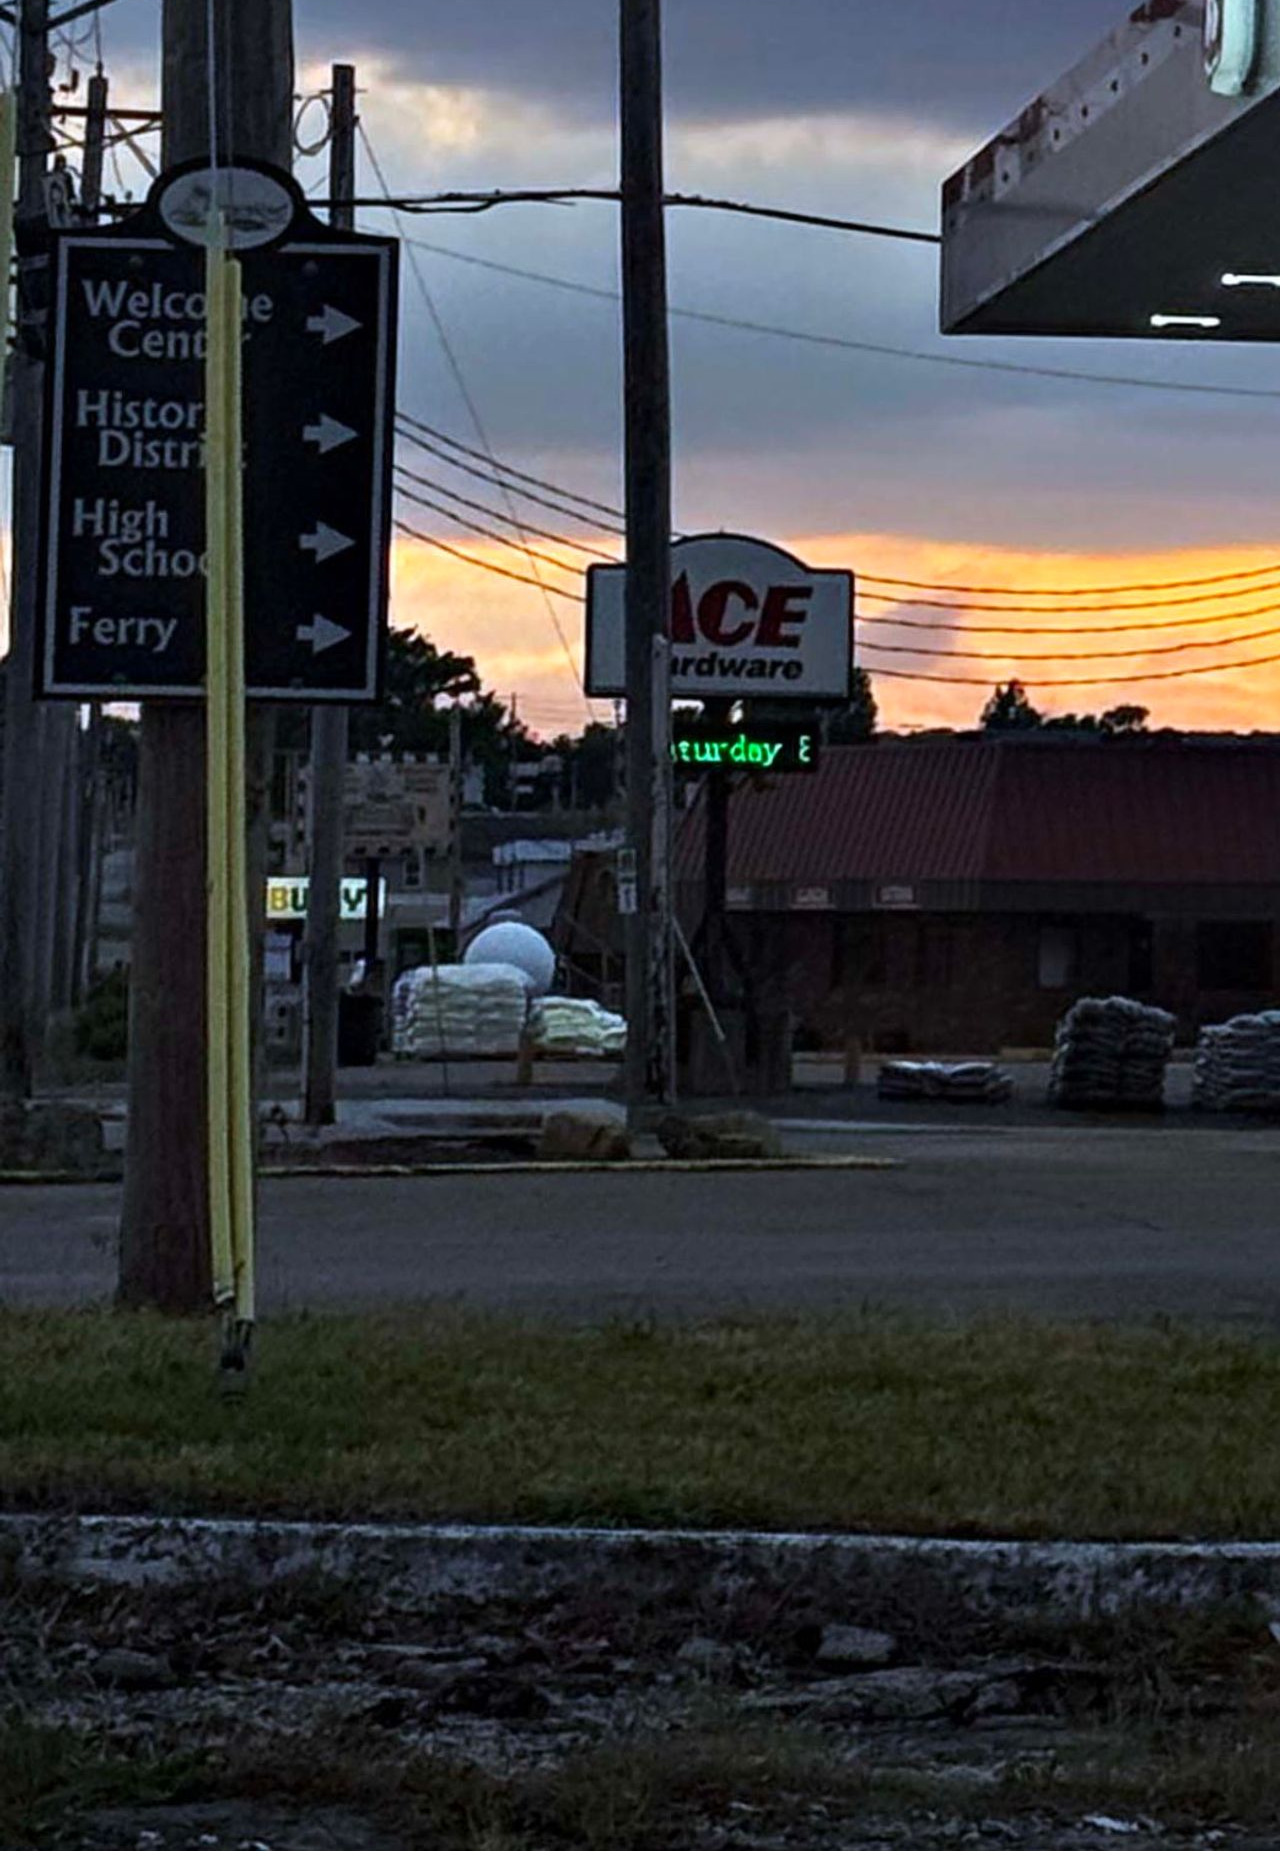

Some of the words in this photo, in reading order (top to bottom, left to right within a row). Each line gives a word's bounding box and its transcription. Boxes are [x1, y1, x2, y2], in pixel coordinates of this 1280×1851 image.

[82, 279, 274, 322] Welcoe
[108, 319, 251, 358] Cent
[76, 389, 205, 429] Histor
[98, 429, 247, 468] Distri
[72, 498, 169, 544] High
[98, 537, 209, 577] Scho
[69, 605, 178, 653] Ferry
[671, 652, 804, 681] rdware
[670, 734, 784, 768] turday
